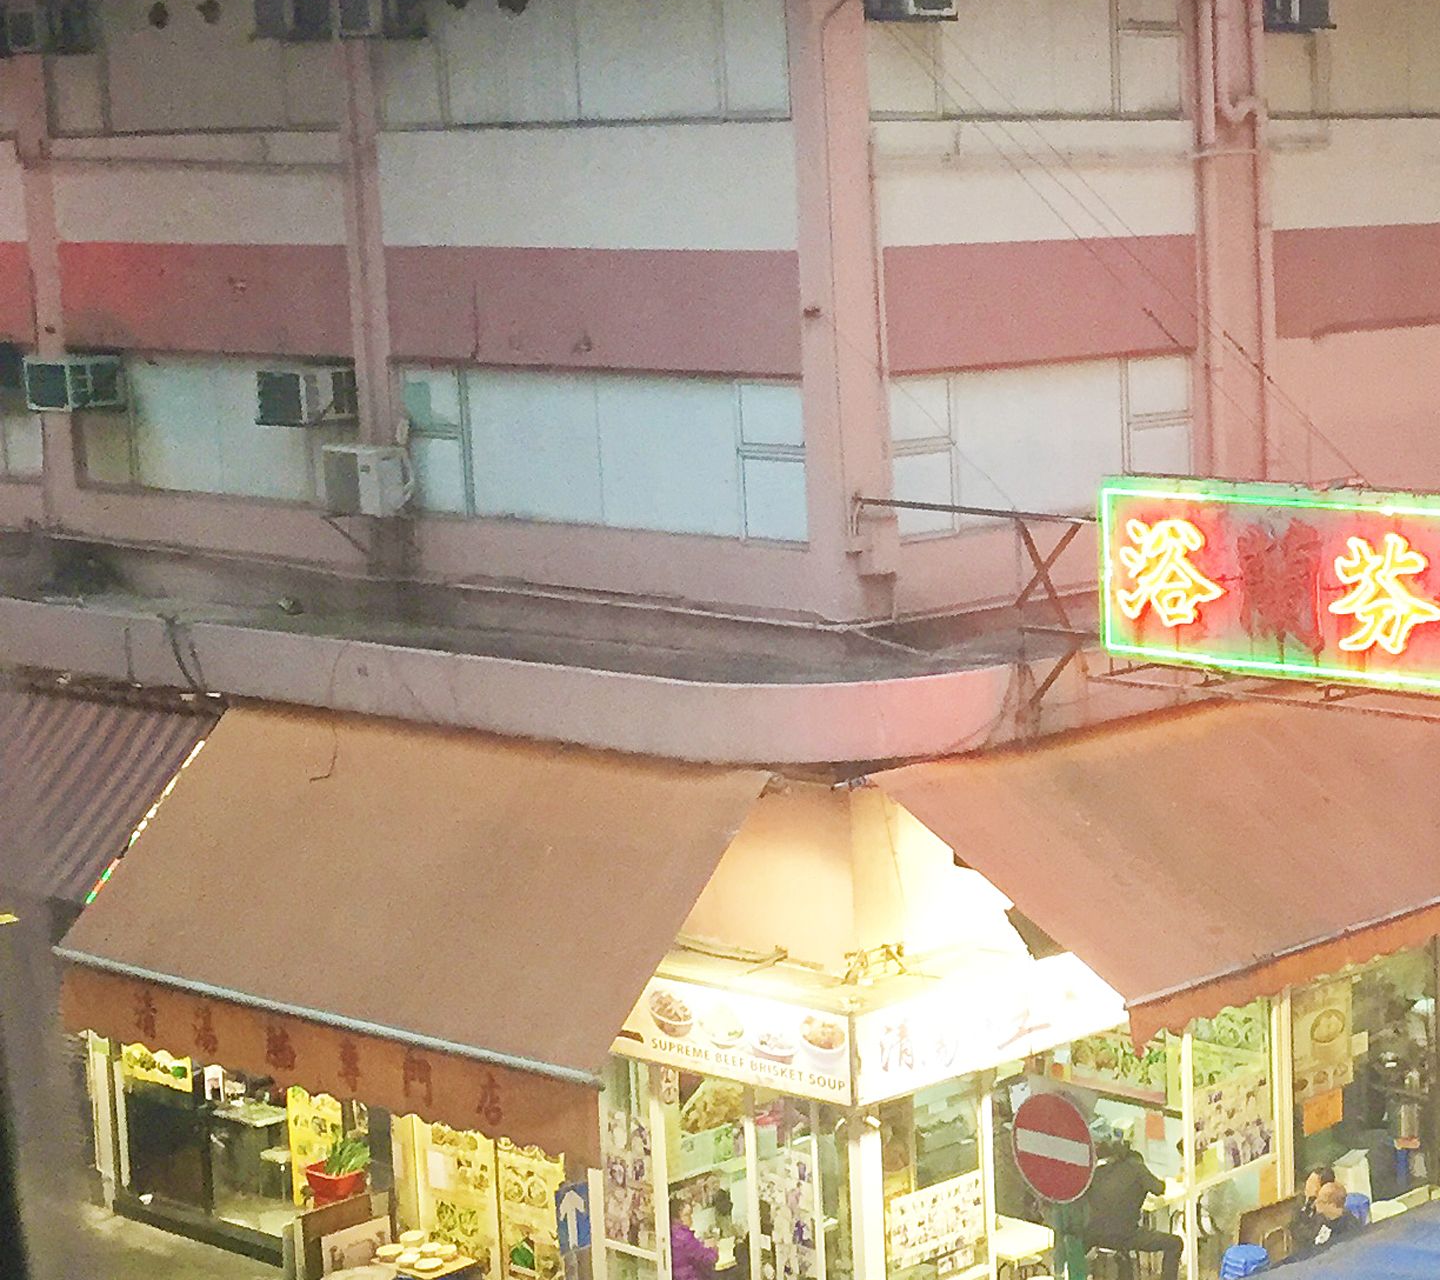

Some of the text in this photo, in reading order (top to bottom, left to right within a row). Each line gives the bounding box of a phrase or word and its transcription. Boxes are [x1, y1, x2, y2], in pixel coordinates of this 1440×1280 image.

[651, 1038, 846, 1091] SUPREME BEEF BRISKET SOUP
